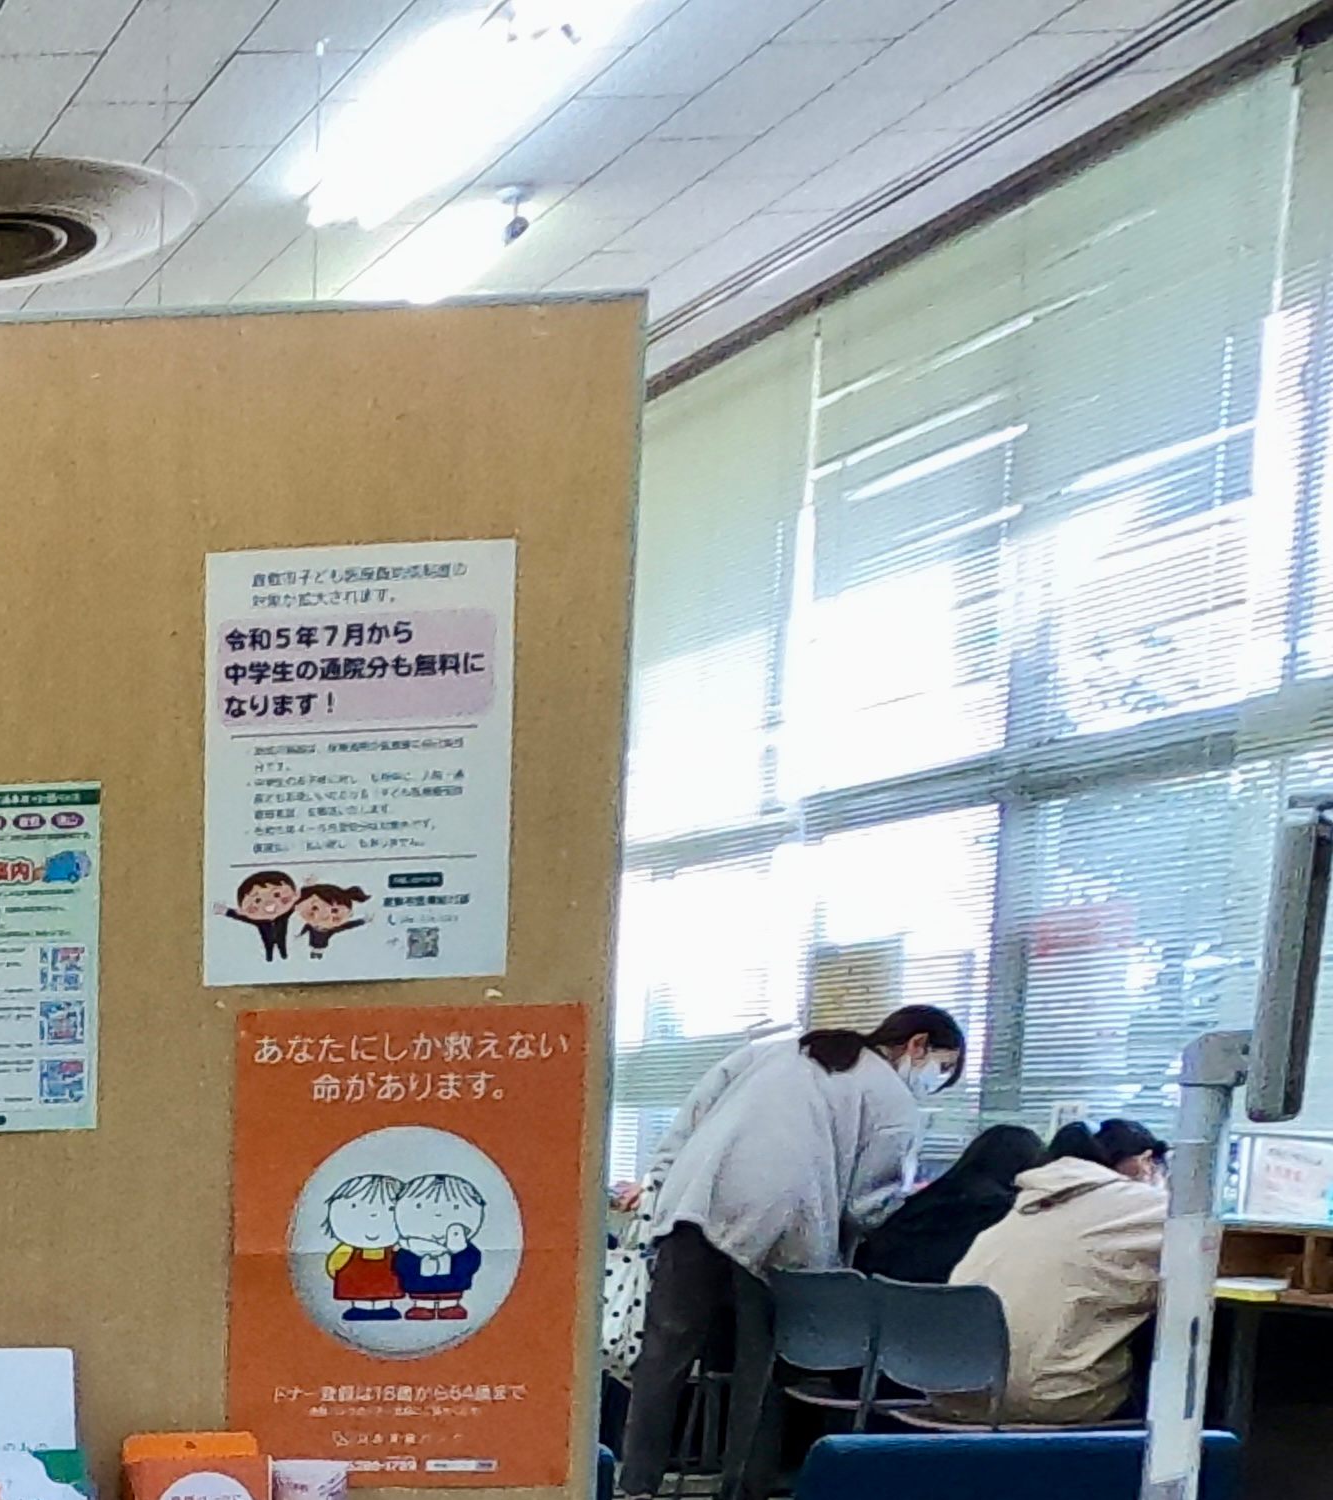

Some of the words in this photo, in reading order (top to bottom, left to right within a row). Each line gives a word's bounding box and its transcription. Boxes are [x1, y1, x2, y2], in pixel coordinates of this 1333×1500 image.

[225, 620, 413, 651] 令和5年7月から
[225, 651, 486, 686] 中学生の通院分も無料に
[224, 691, 334, 718] なります!
[253, 1032, 569, 1065] あなたにしか救えない
[312, 1072, 505, 1102] 命があります。
